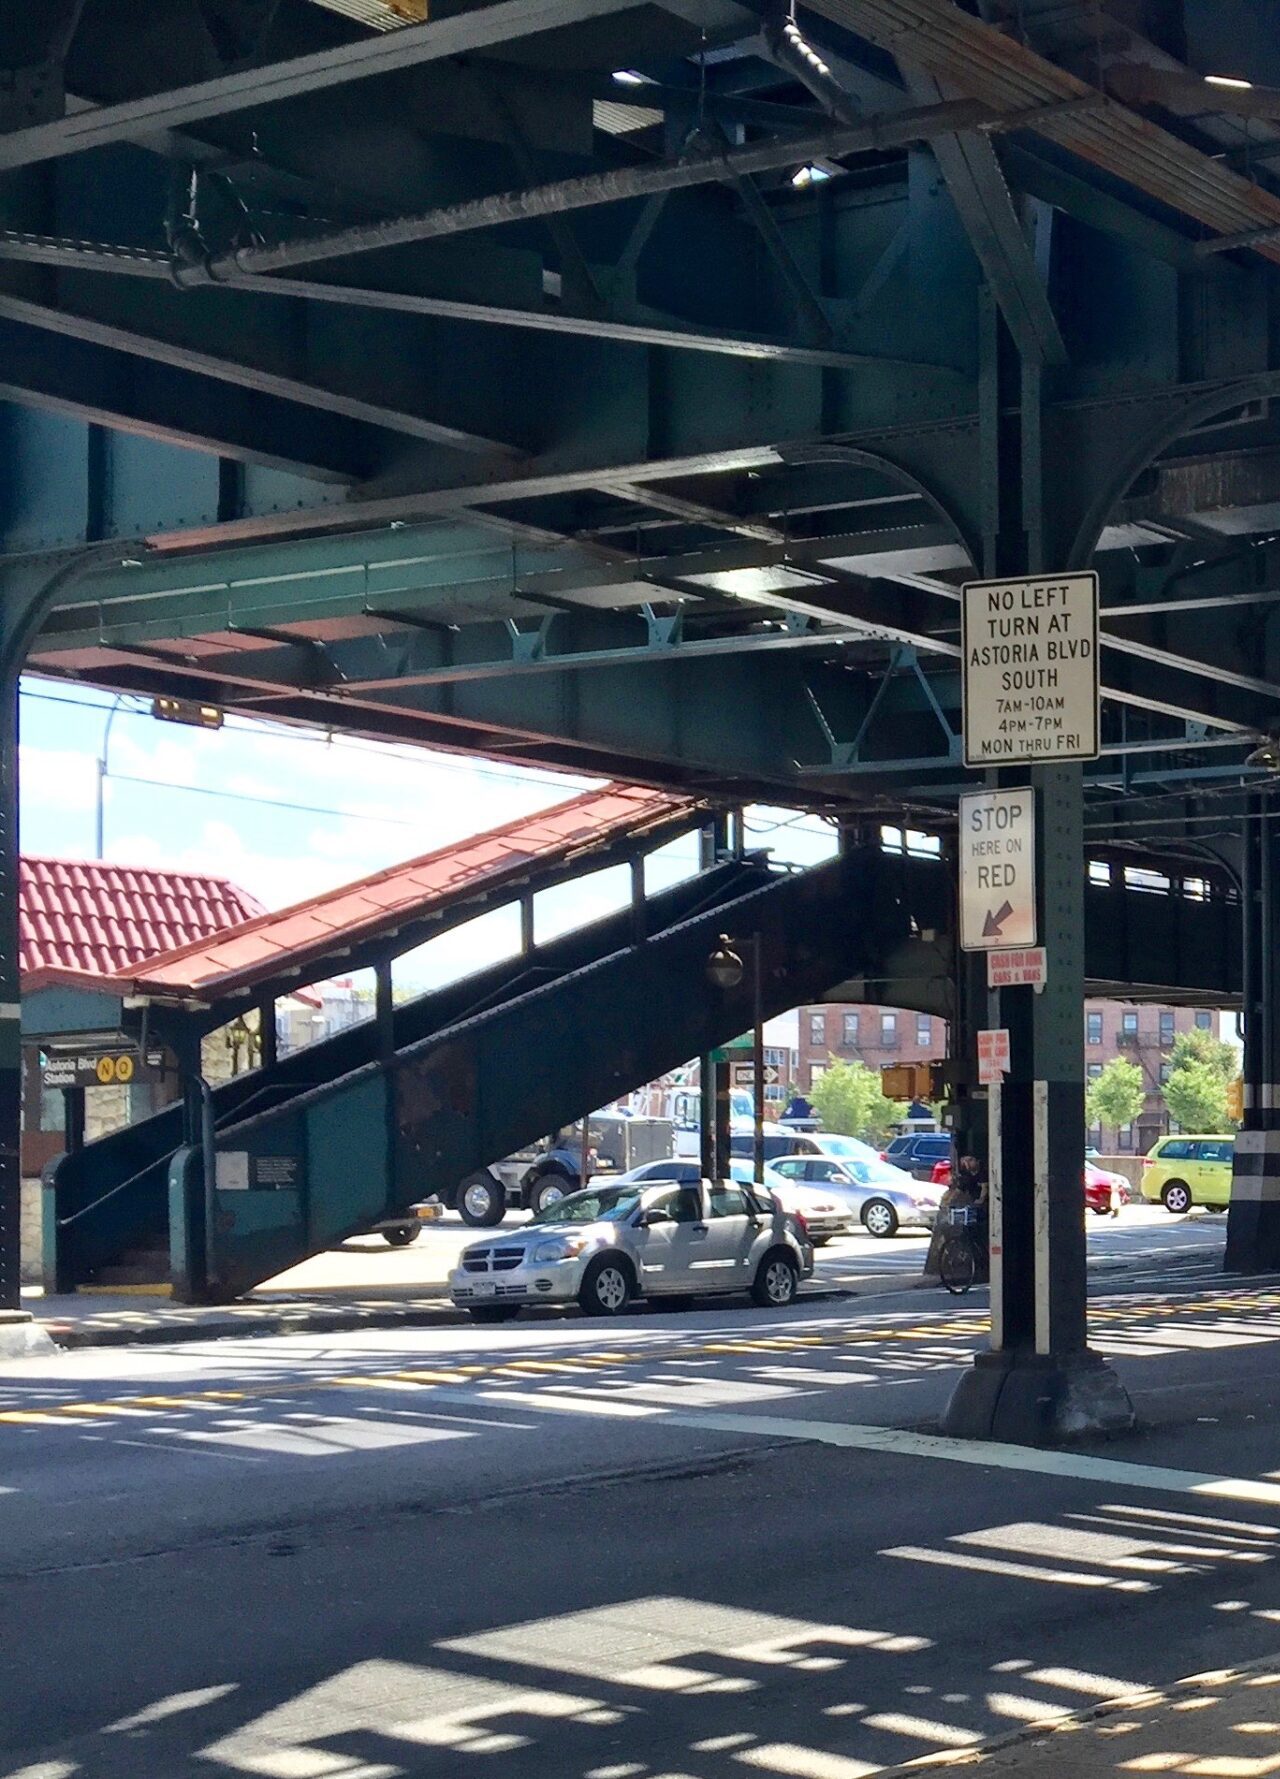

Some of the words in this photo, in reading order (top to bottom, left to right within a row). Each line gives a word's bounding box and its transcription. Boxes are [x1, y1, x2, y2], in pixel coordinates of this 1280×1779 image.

[988, 591, 1014, 612] NO
[1021, 586, 1069, 609] LEFT
[987, 615, 1039, 639] TURN
[1047, 613, 1072, 634] AT
[970, 643, 1039, 667] ASTORIA
[1047, 638, 1091, 661] BLVD
[1001, 668, 1058, 691] SOUTH
[981, 738, 1013, 755] MON
[1018, 737, 1052, 753] THRU
[1056, 734, 1080, 750] FRI
[971, 804, 1022, 833] STOP
[971, 840, 1001, 857] HERE
[1006, 838, 1022, 853] ON
[977, 863, 1016, 889] RED
[45, 1057, 76, 1072] Astoria
[77, 1056, 97, 1070] Blvd
[44, 1072, 76, 1085] Station
